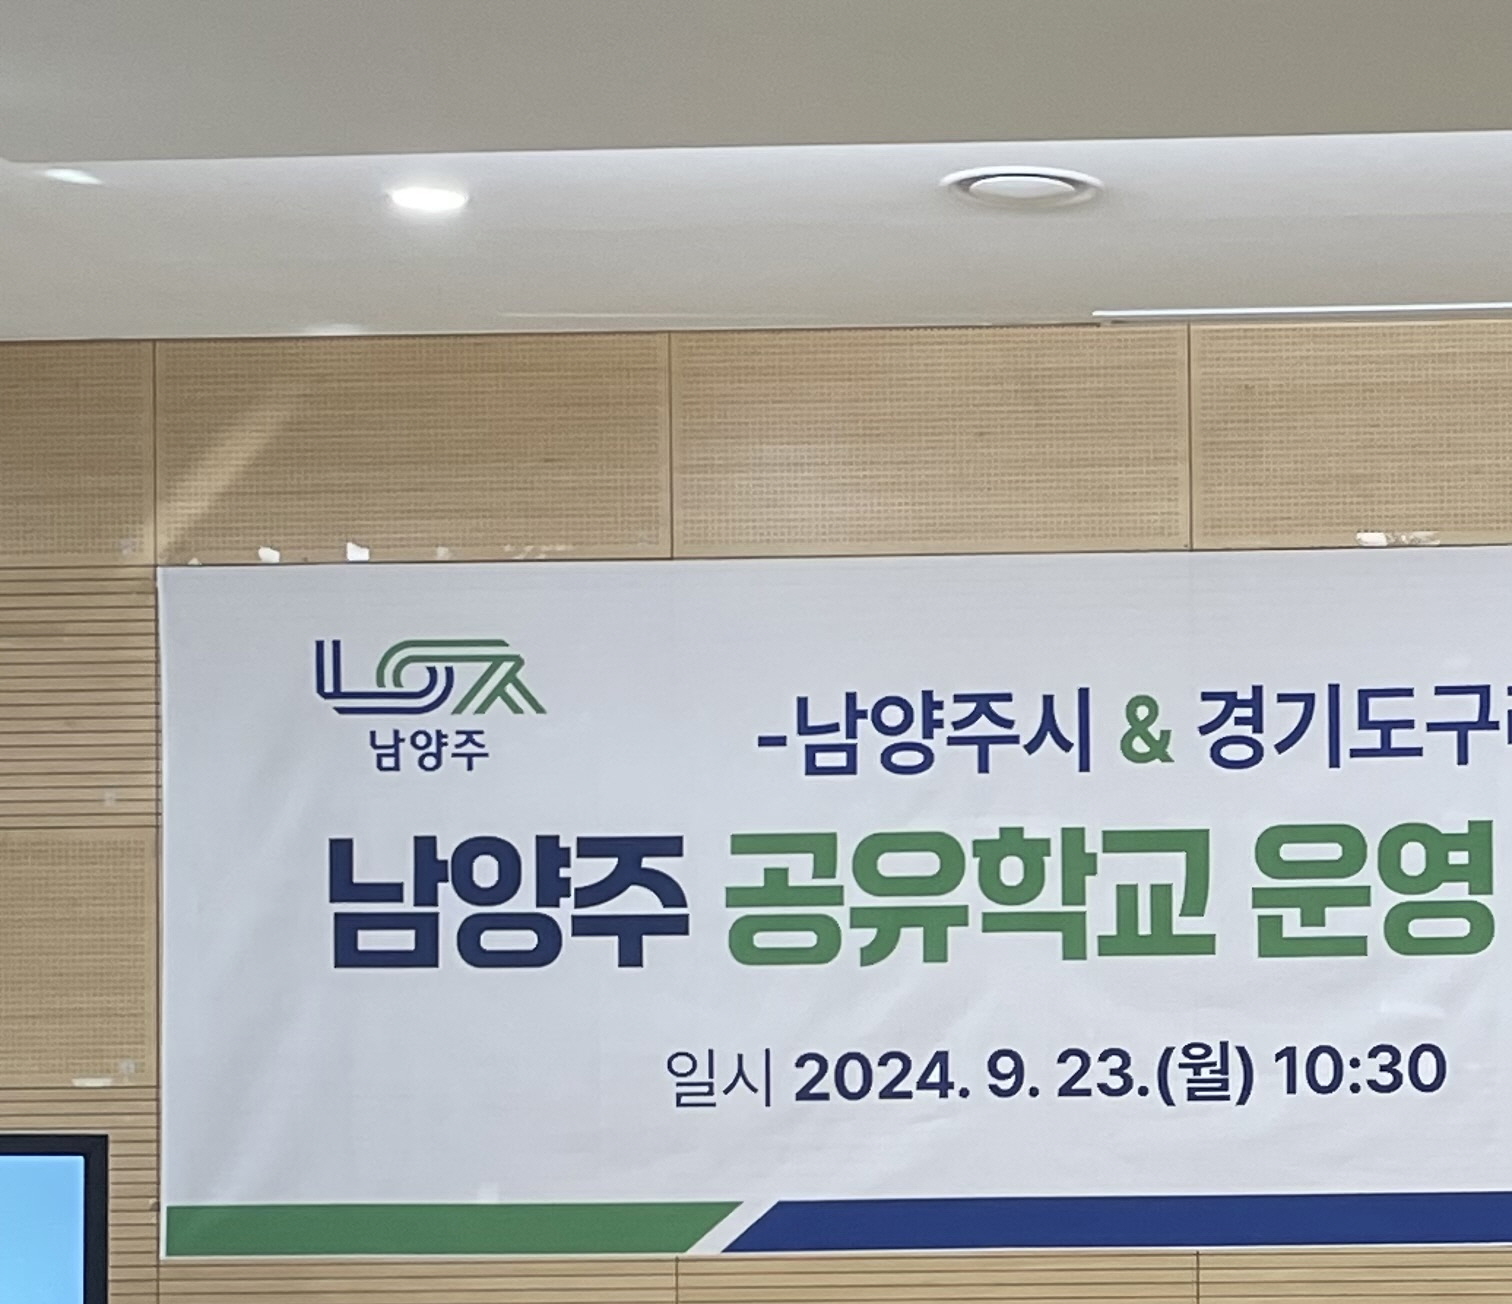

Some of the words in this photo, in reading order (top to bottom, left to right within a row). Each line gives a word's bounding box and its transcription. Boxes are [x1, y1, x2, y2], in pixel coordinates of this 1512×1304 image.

[369, 729, 490, 772] 남양주
[758, 687, 1091, 777] -남양주시
[1120, 694, 1175, 763] &
[329, 834, 690, 969] 남양주
[725, 827, 1217, 967] 공유학교
[1251, 820, 1496, 959] 운영
[666, 1047, 771, 1107] 일시
[794, 1050, 971, 1102] 2024.
[986, 1048, 1040, 1099] 9.
[1056, 1040, 1254, 1106] 23.(월)
[1274, 1042, 1447, 1096] 10:30
